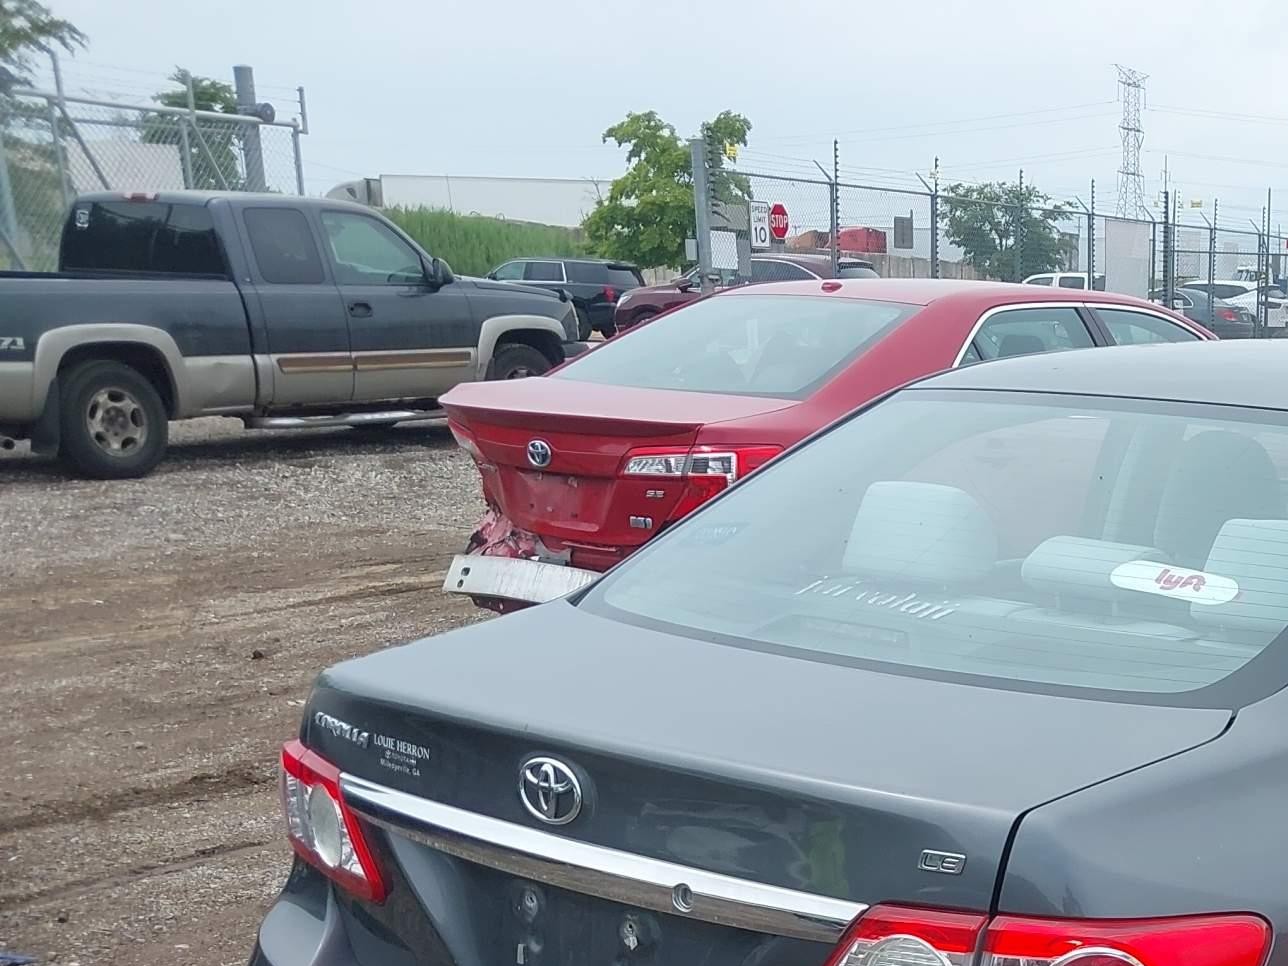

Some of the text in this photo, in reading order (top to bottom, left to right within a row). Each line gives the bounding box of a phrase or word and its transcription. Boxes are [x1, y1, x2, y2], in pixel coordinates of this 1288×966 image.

[751, 204, 768, 214] SPEED
[753, 214, 767, 223] LIMIT
[771, 215, 788, 228] STOP
[754, 226, 767, 244] 10
[646, 489, 664, 498] SE
[1155, 568, 1207, 592] lyft
[373, 733, 430, 760] LOUIE HERRON
[922, 853, 961, 873] LE
